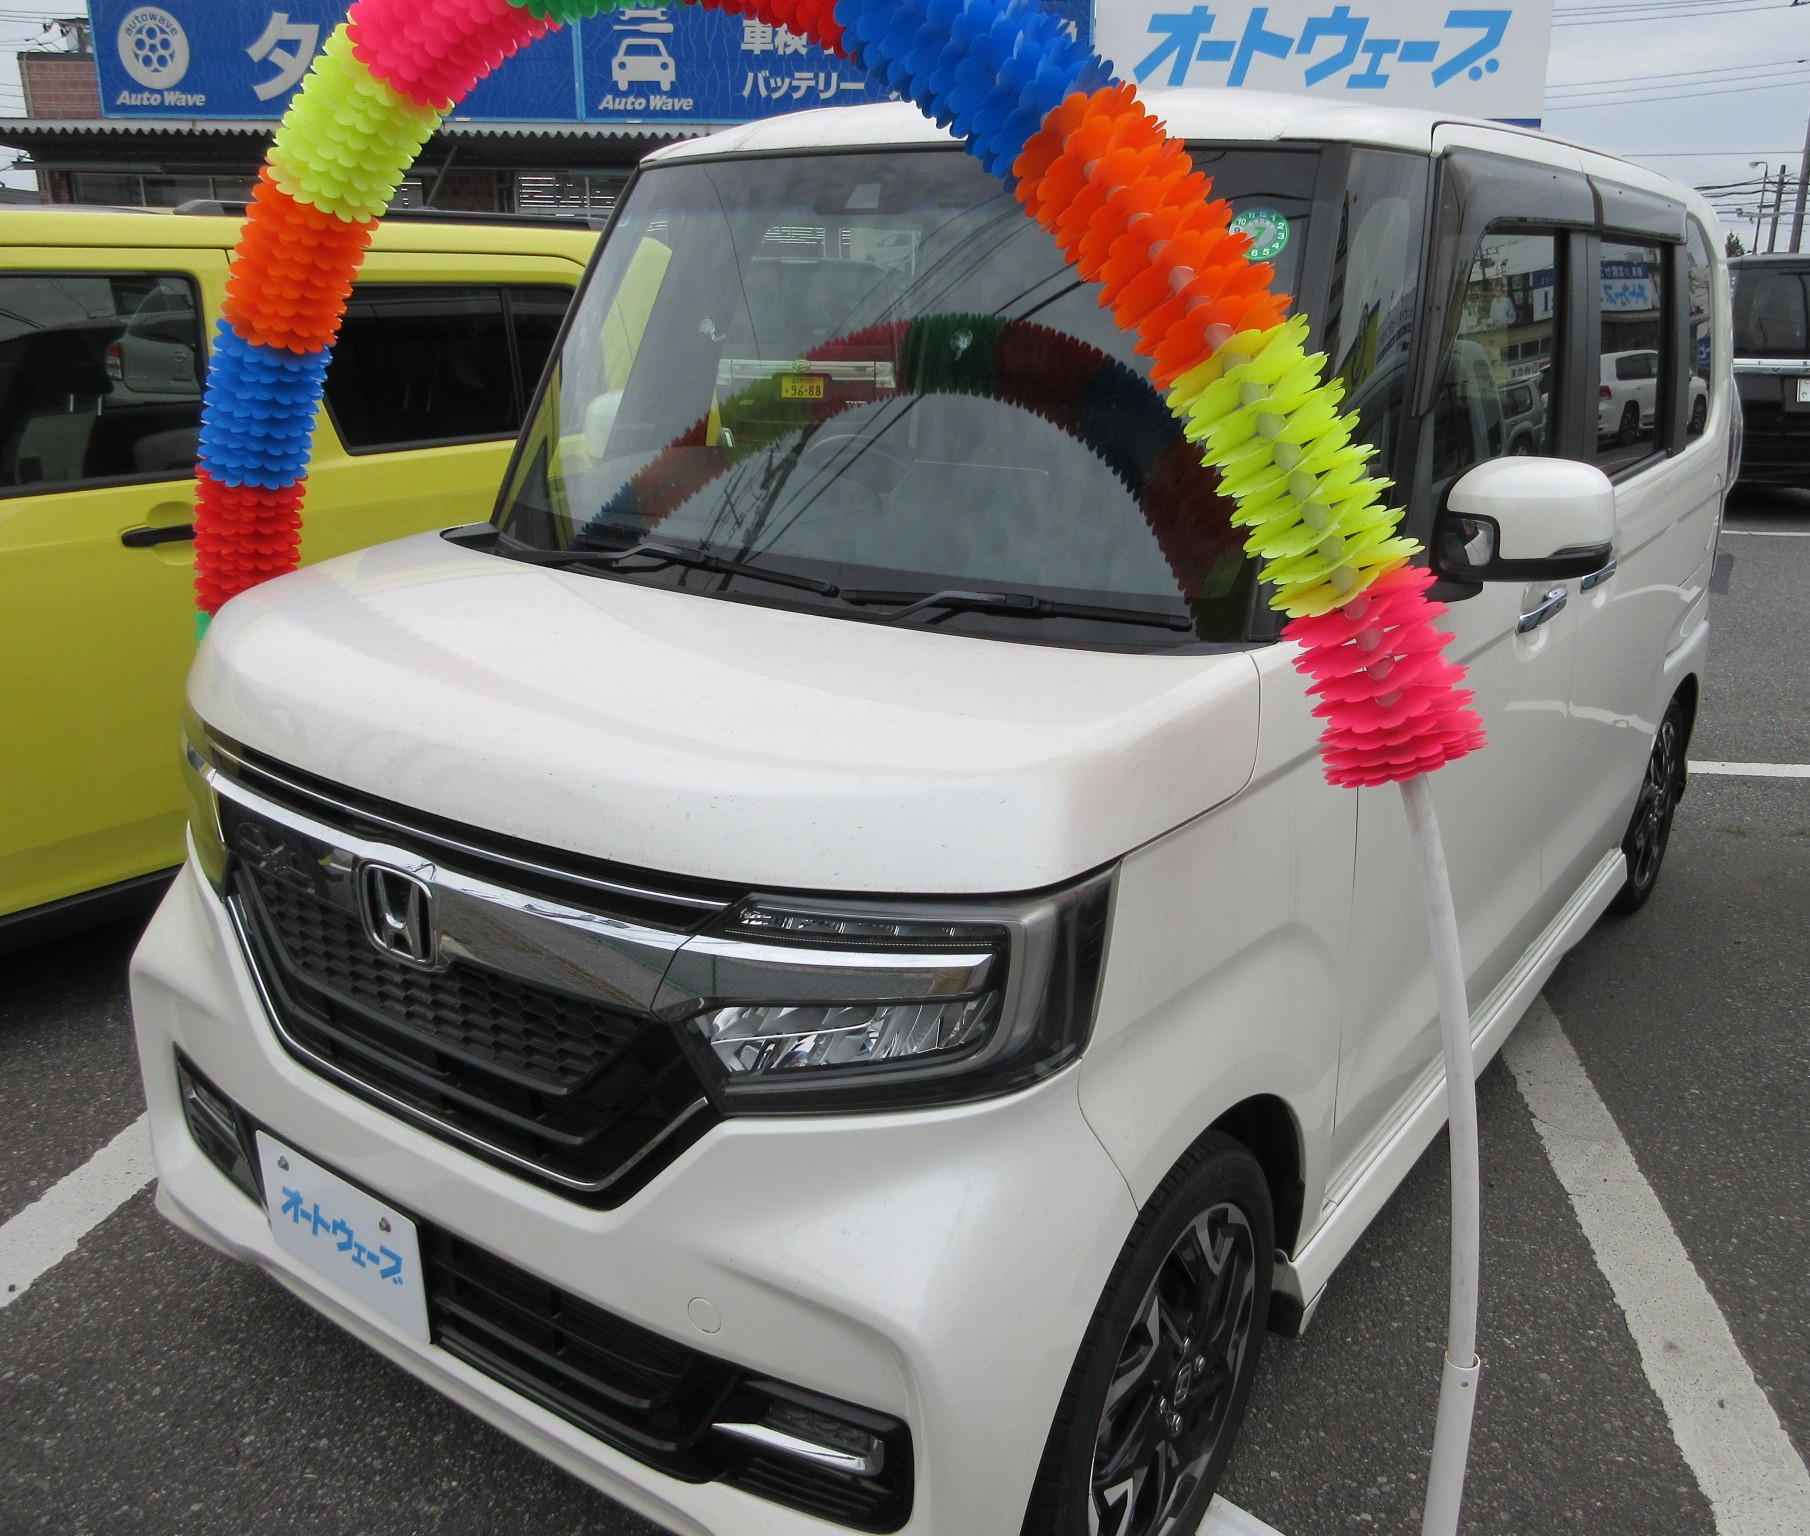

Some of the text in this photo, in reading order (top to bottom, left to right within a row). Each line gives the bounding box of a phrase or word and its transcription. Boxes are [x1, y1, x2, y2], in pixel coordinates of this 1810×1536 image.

[1132, 5, 1513, 89] オートウェーブ
[742, 70, 865, 100] バッテリー
[116, 90, 206, 106] Auto Wave
[598, 94, 694, 111] Auto Wave
[1259, 210, 1267, 218] 12
[1253, 226, 1266, 242] 7
[791, 385, 821, 396] 96-88
[281, 1186, 403, 1285] オートウェーブ
